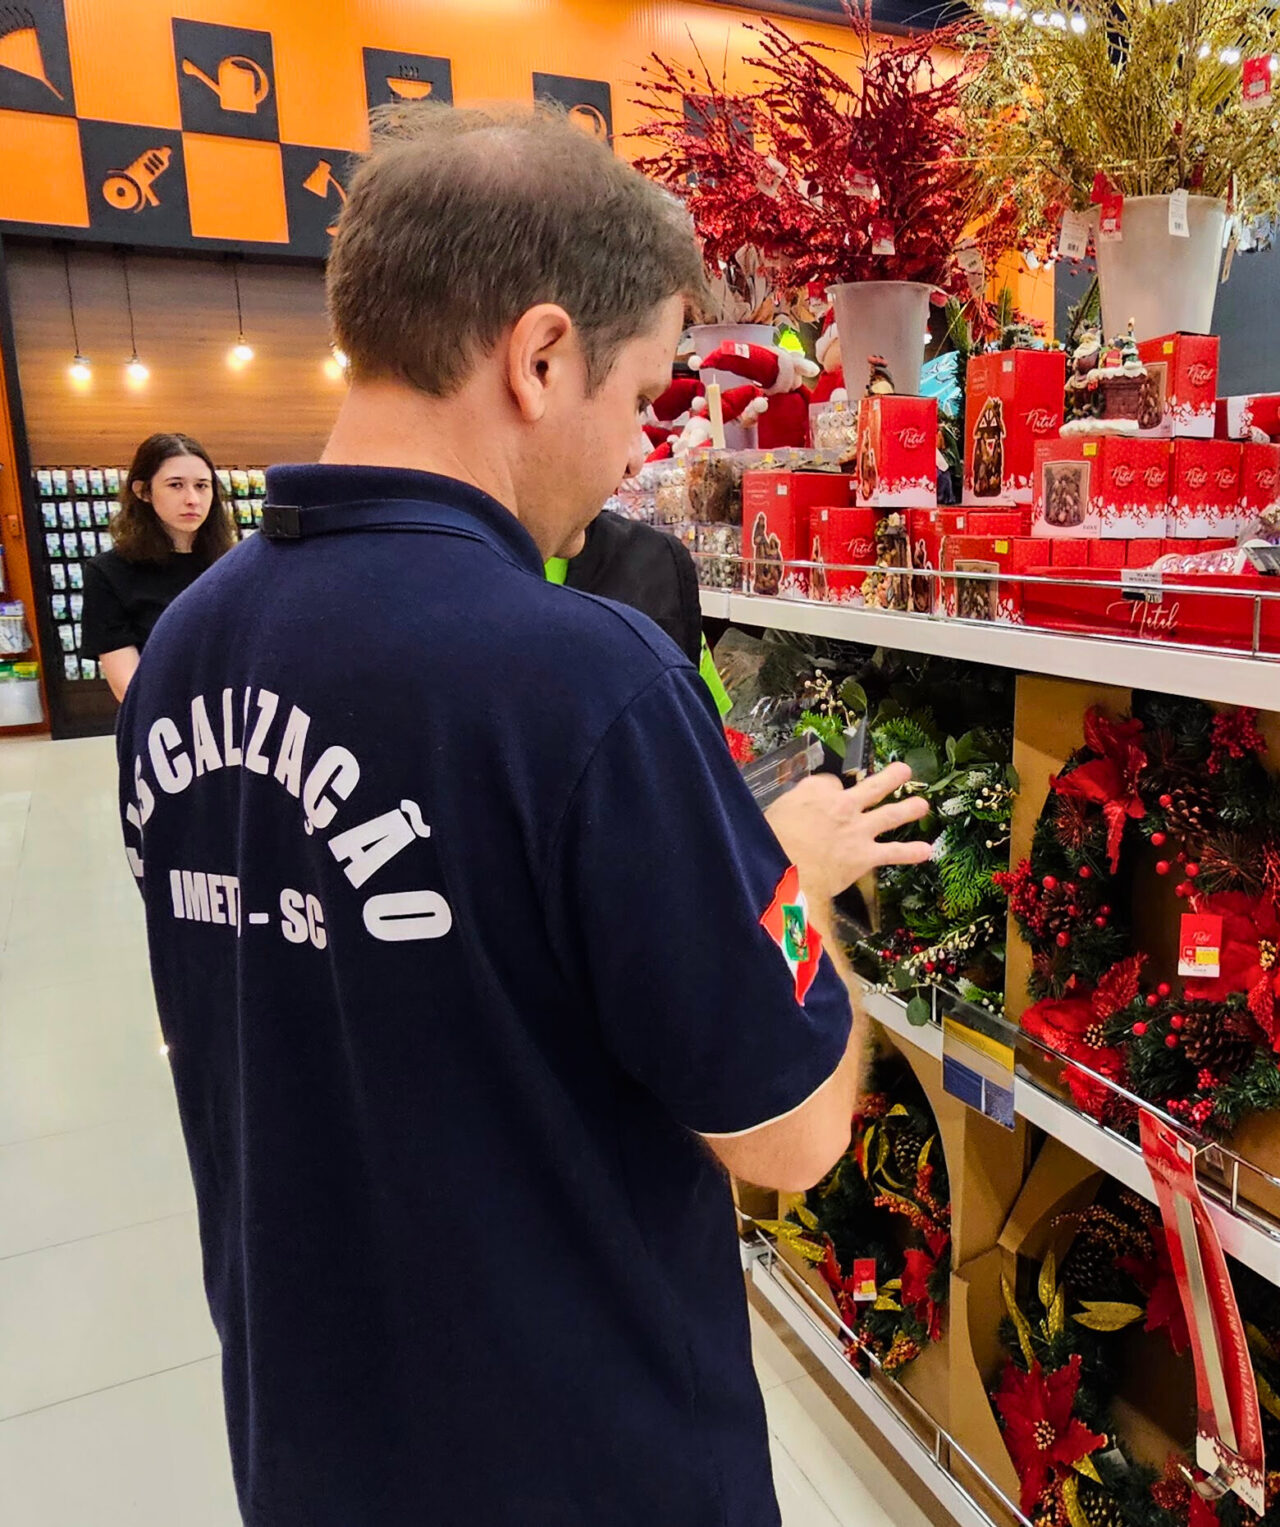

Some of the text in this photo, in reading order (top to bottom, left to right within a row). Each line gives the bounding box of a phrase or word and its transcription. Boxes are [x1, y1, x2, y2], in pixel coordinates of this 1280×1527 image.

[1019, 407, 1059, 434] Natal
[893, 427, 926, 448] Natal
[841, 537, 874, 558] Natal
[126, 686, 453, 942] SCALZAÇÃO
[169, 869, 241, 938] IMET
[280, 888, 327, 950] SC
